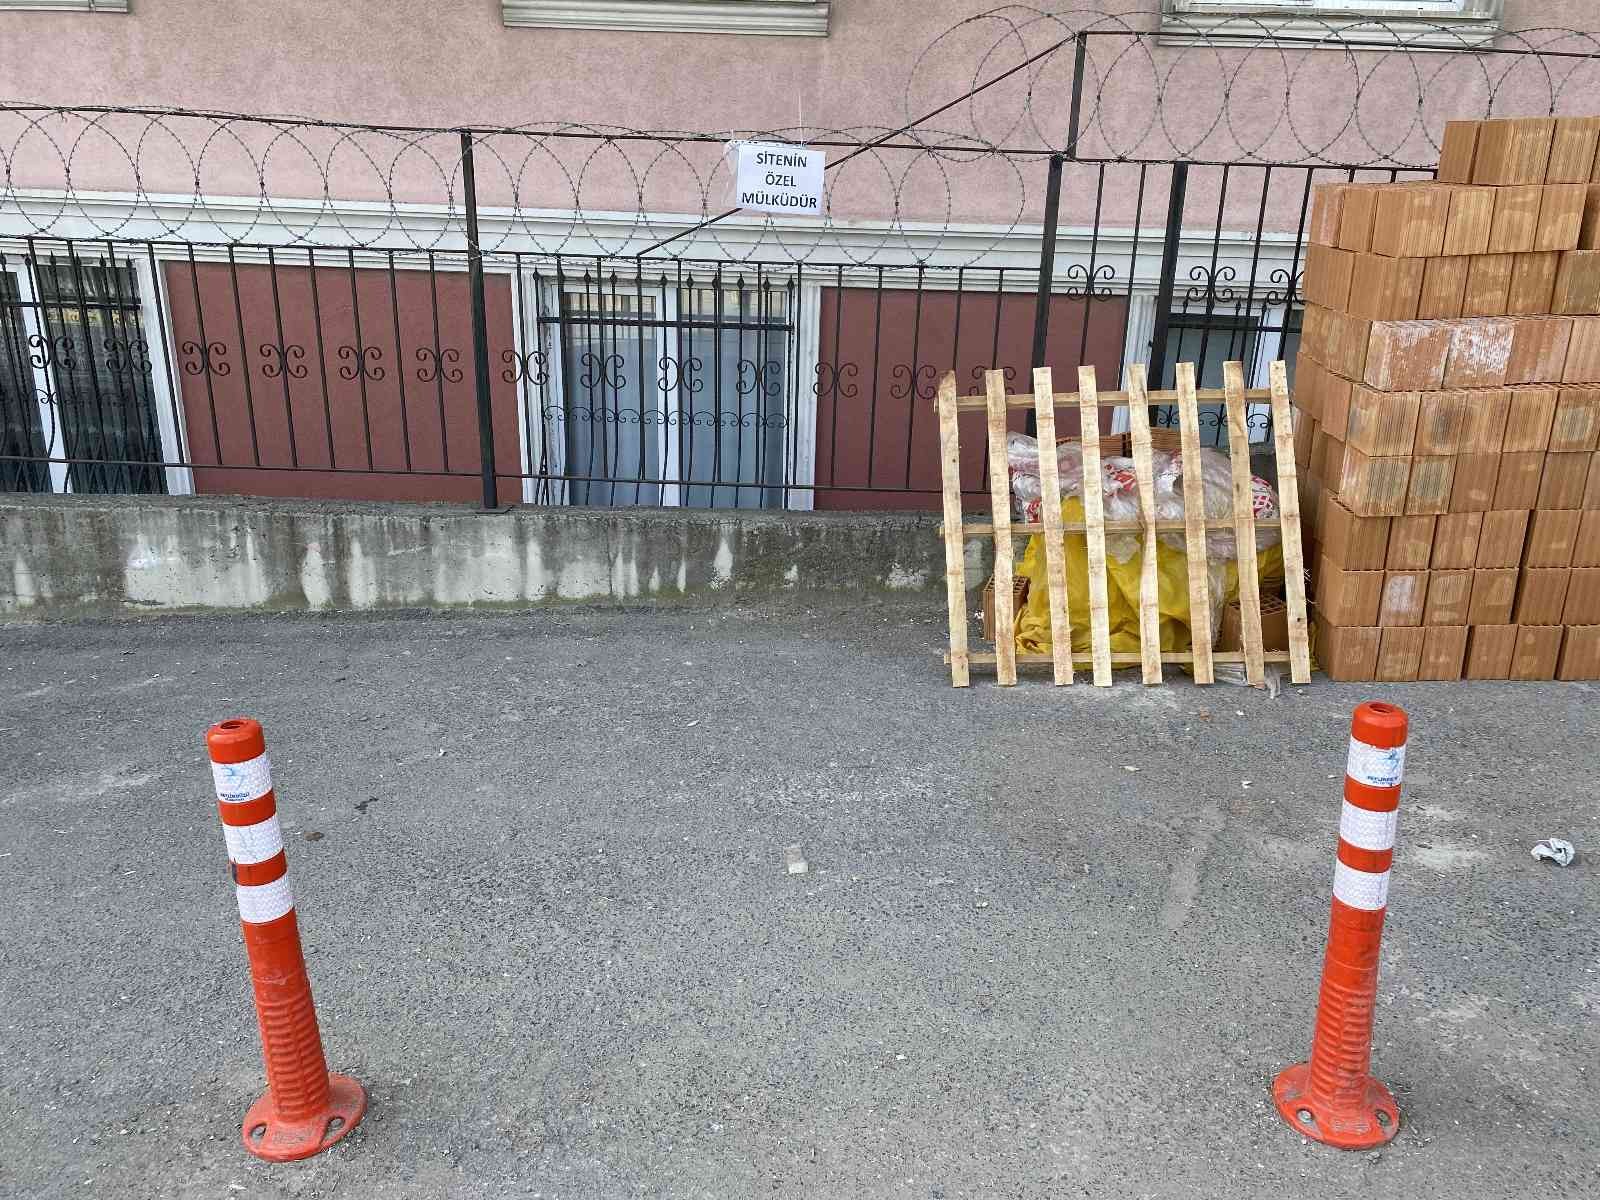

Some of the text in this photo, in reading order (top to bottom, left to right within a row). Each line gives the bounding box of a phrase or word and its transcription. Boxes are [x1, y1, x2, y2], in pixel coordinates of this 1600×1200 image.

[756, 151, 808, 168] SİTENİN
[765, 170, 797, 187] ÖZEL
[742, 191, 817, 208] MÜLKÜDÜR
